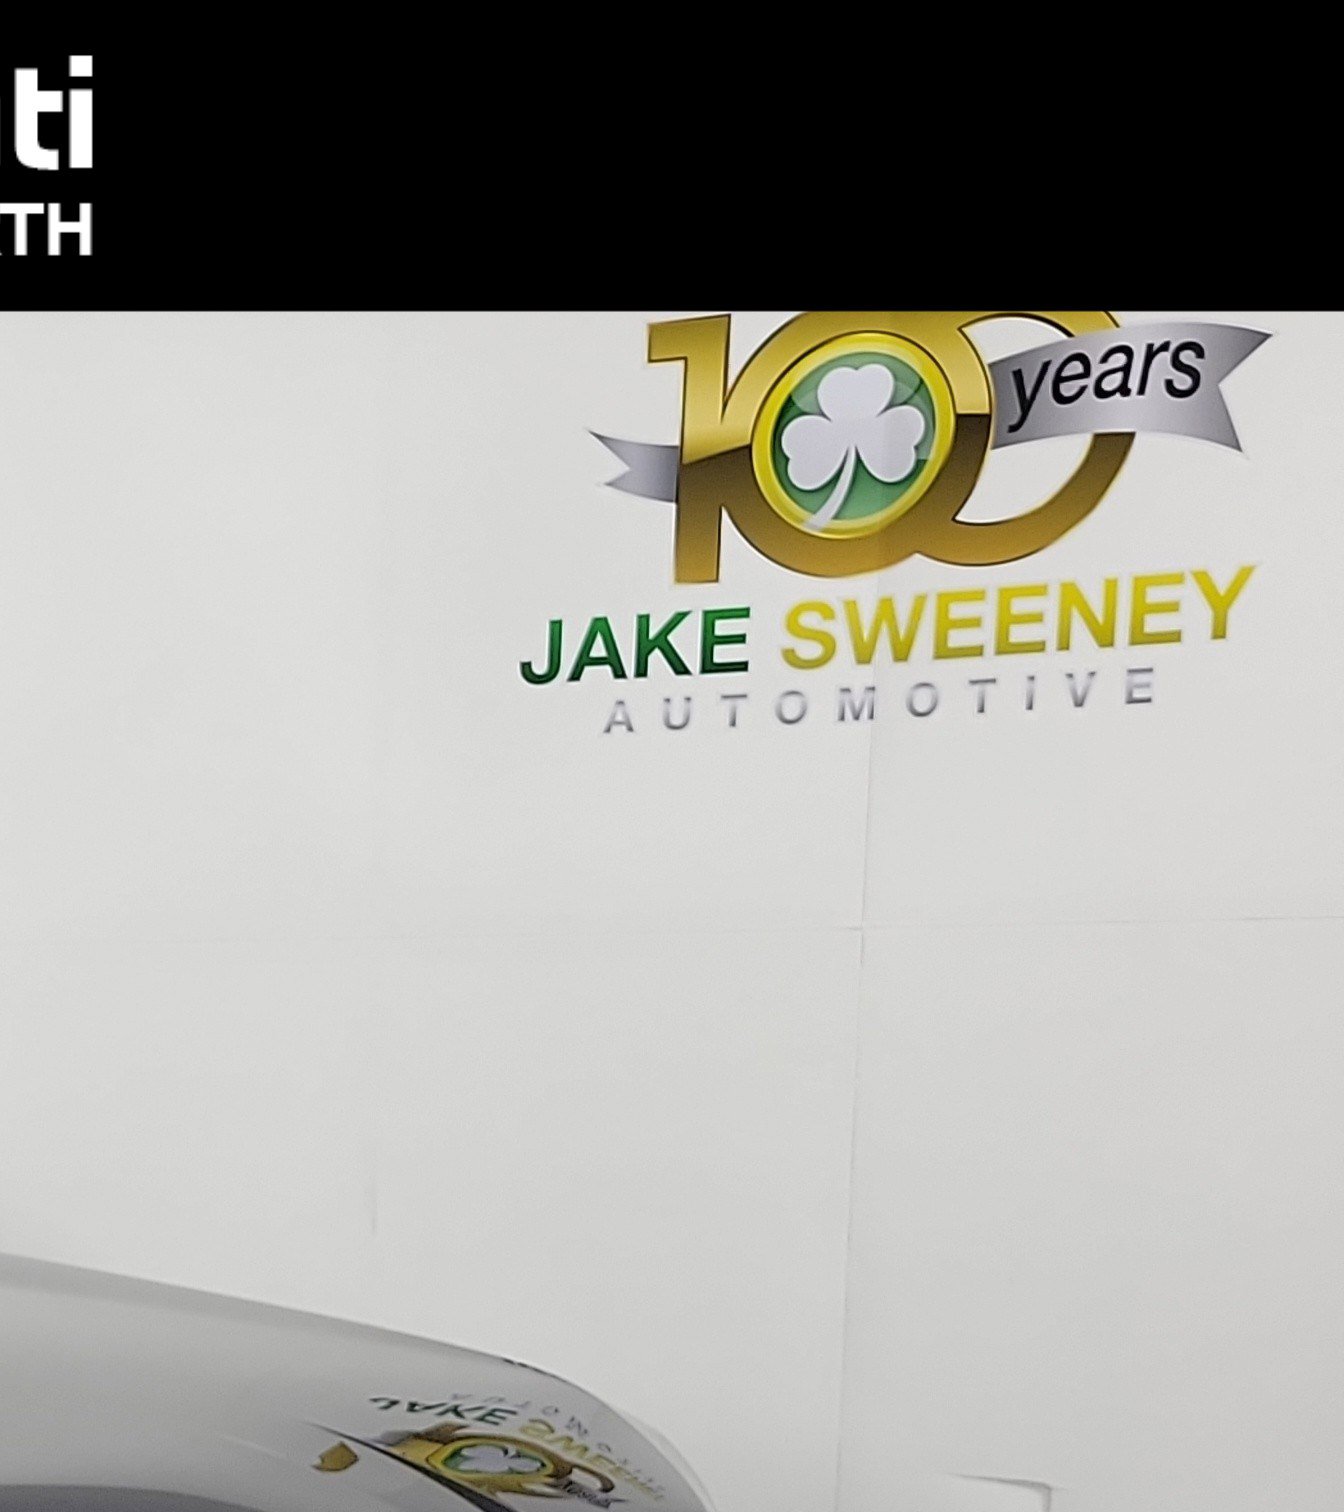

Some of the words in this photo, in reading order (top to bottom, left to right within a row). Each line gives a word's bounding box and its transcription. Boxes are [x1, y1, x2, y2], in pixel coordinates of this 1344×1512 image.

[647, 311, 1135, 584] 100
[1007, 339, 1206, 432] years
[520, 607, 751, 685] JAKE
[780, 564, 1257, 670] SWEENEY
[603, 667, 1156, 734] AUTOMOTIVE
